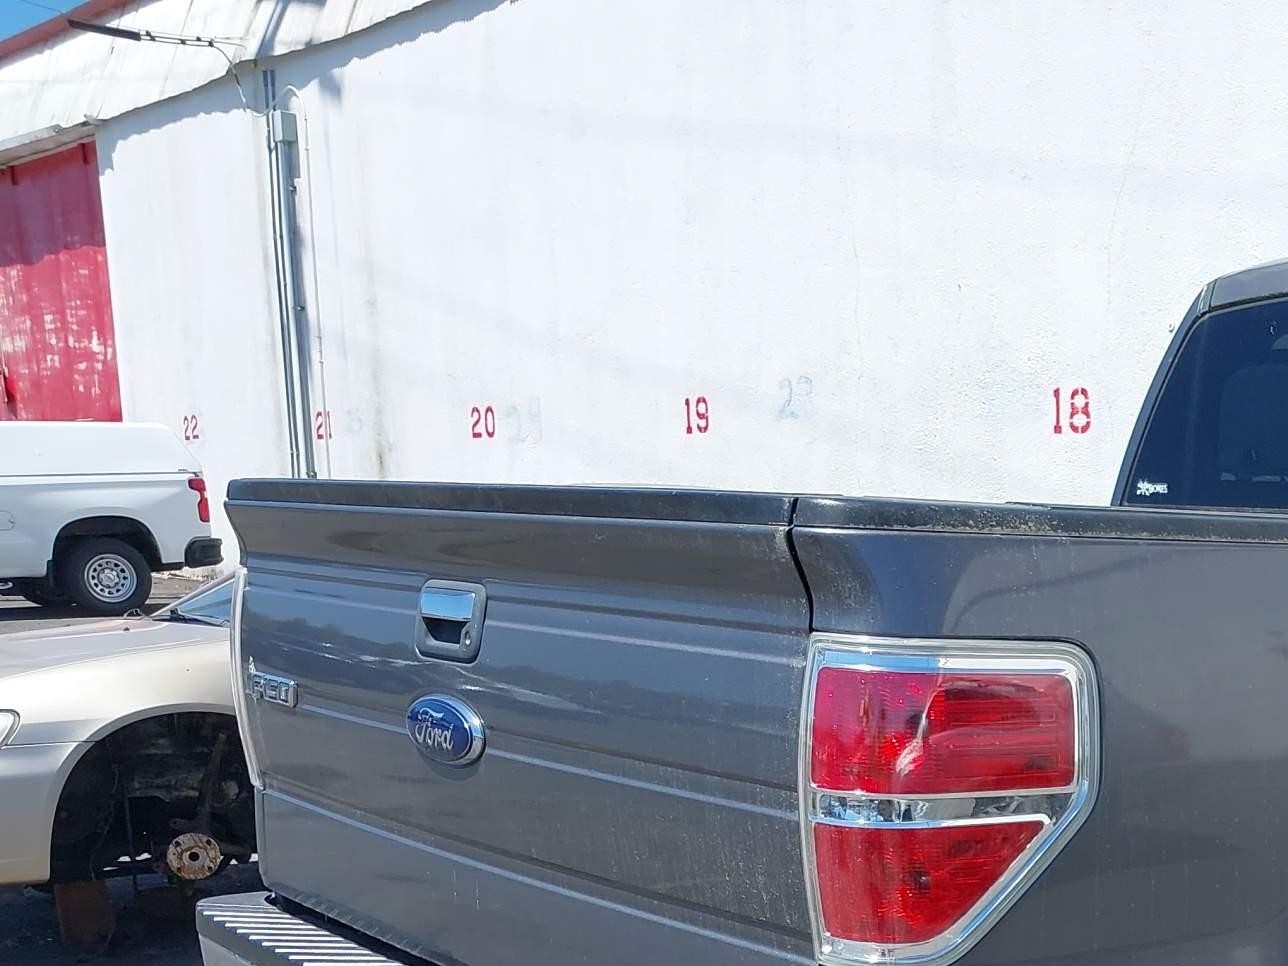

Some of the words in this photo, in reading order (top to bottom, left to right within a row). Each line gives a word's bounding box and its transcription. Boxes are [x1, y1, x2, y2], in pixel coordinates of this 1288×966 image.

[183, 414, 199, 440] 22
[315, 410, 332, 440] 21
[470, 405, 496, 438] 20
[684, 396, 709, 434] 19
[1053, 387, 1091, 434] 18
[415, 707, 455, 751] Ford
